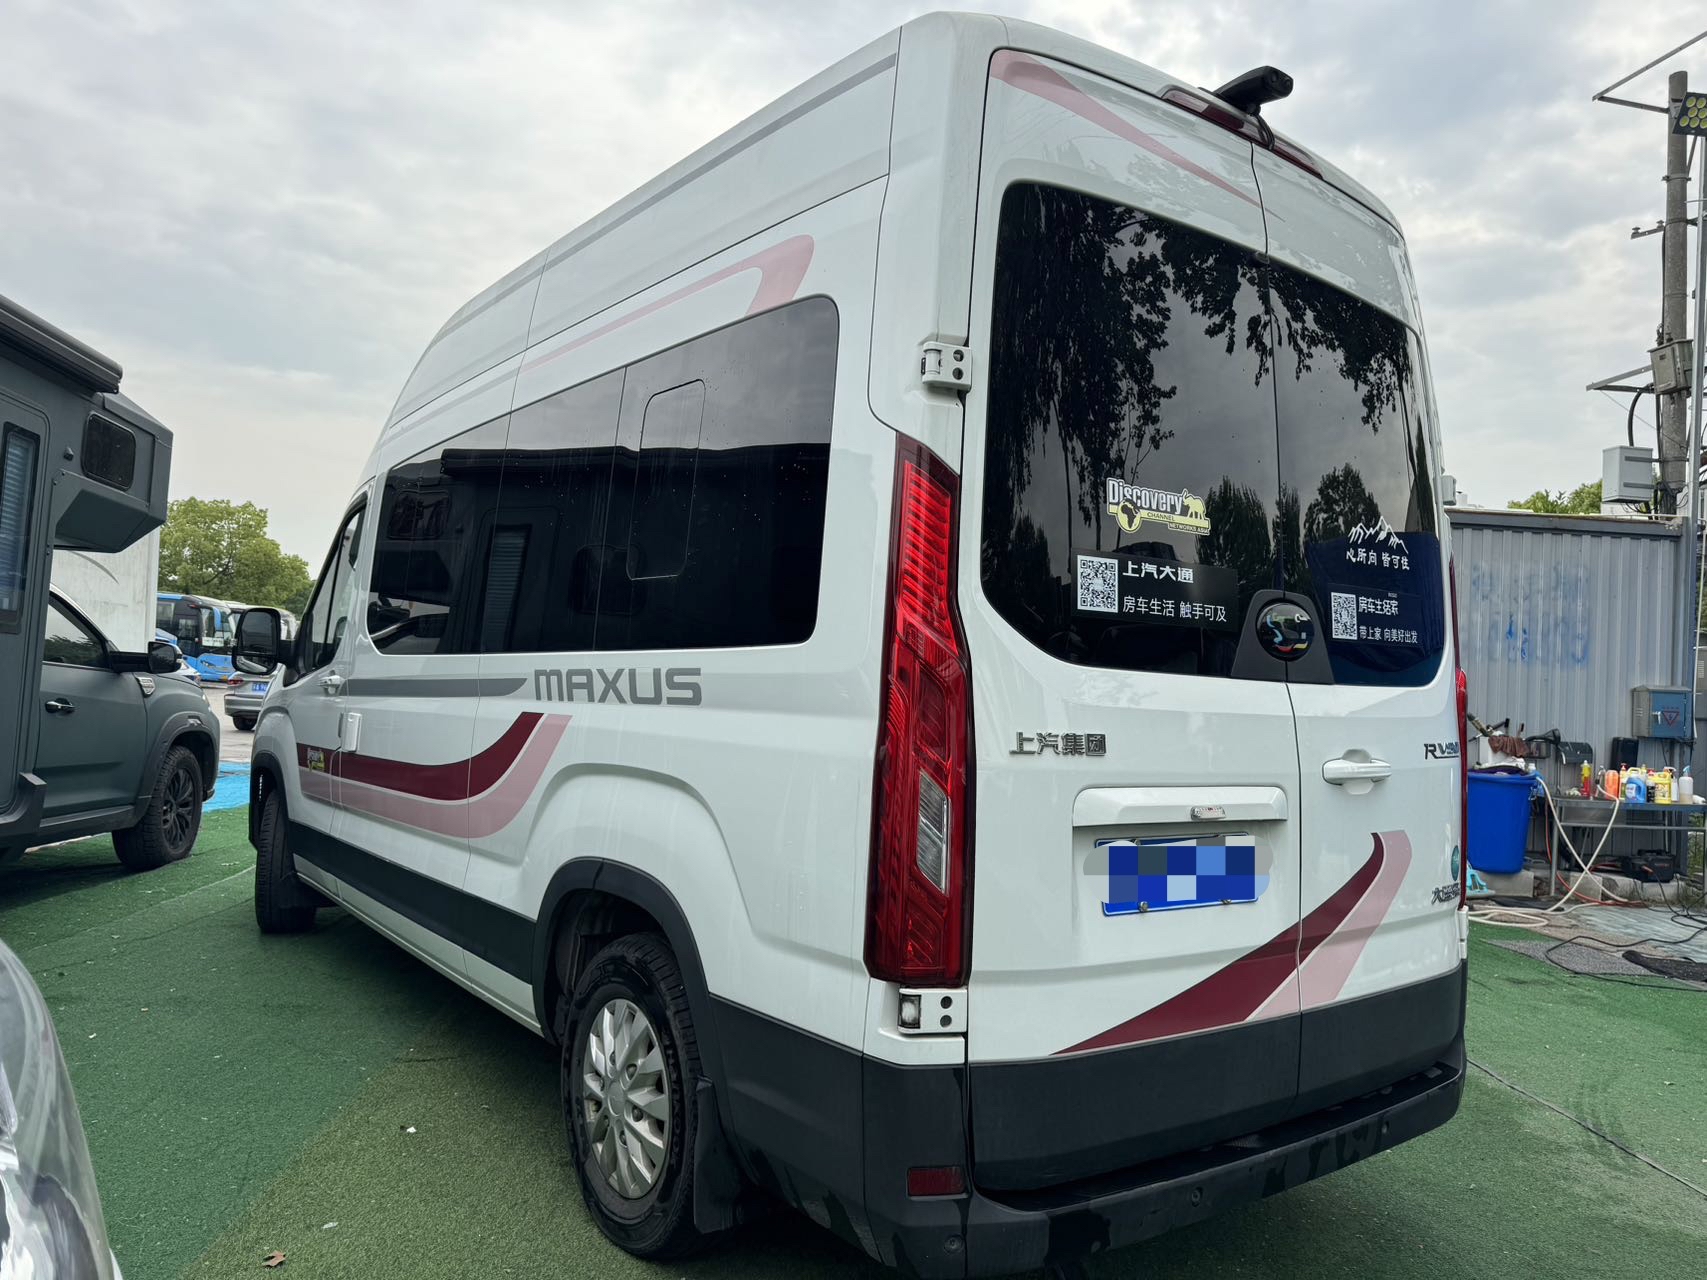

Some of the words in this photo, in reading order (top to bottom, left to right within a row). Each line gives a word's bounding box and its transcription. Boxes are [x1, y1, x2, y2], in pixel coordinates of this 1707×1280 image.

[1108, 480, 1183, 515] Discovery
[1147, 511, 1175, 522] CHANNEL
[1122, 560, 1194, 584] 上汽大通
[1122, 595, 1175, 618] 房车生活
[1179, 600, 1227, 623] 触手可及
[534, 667, 702, 706] MAXUS
[1009, 732, 1107, 756] 上汽集团
